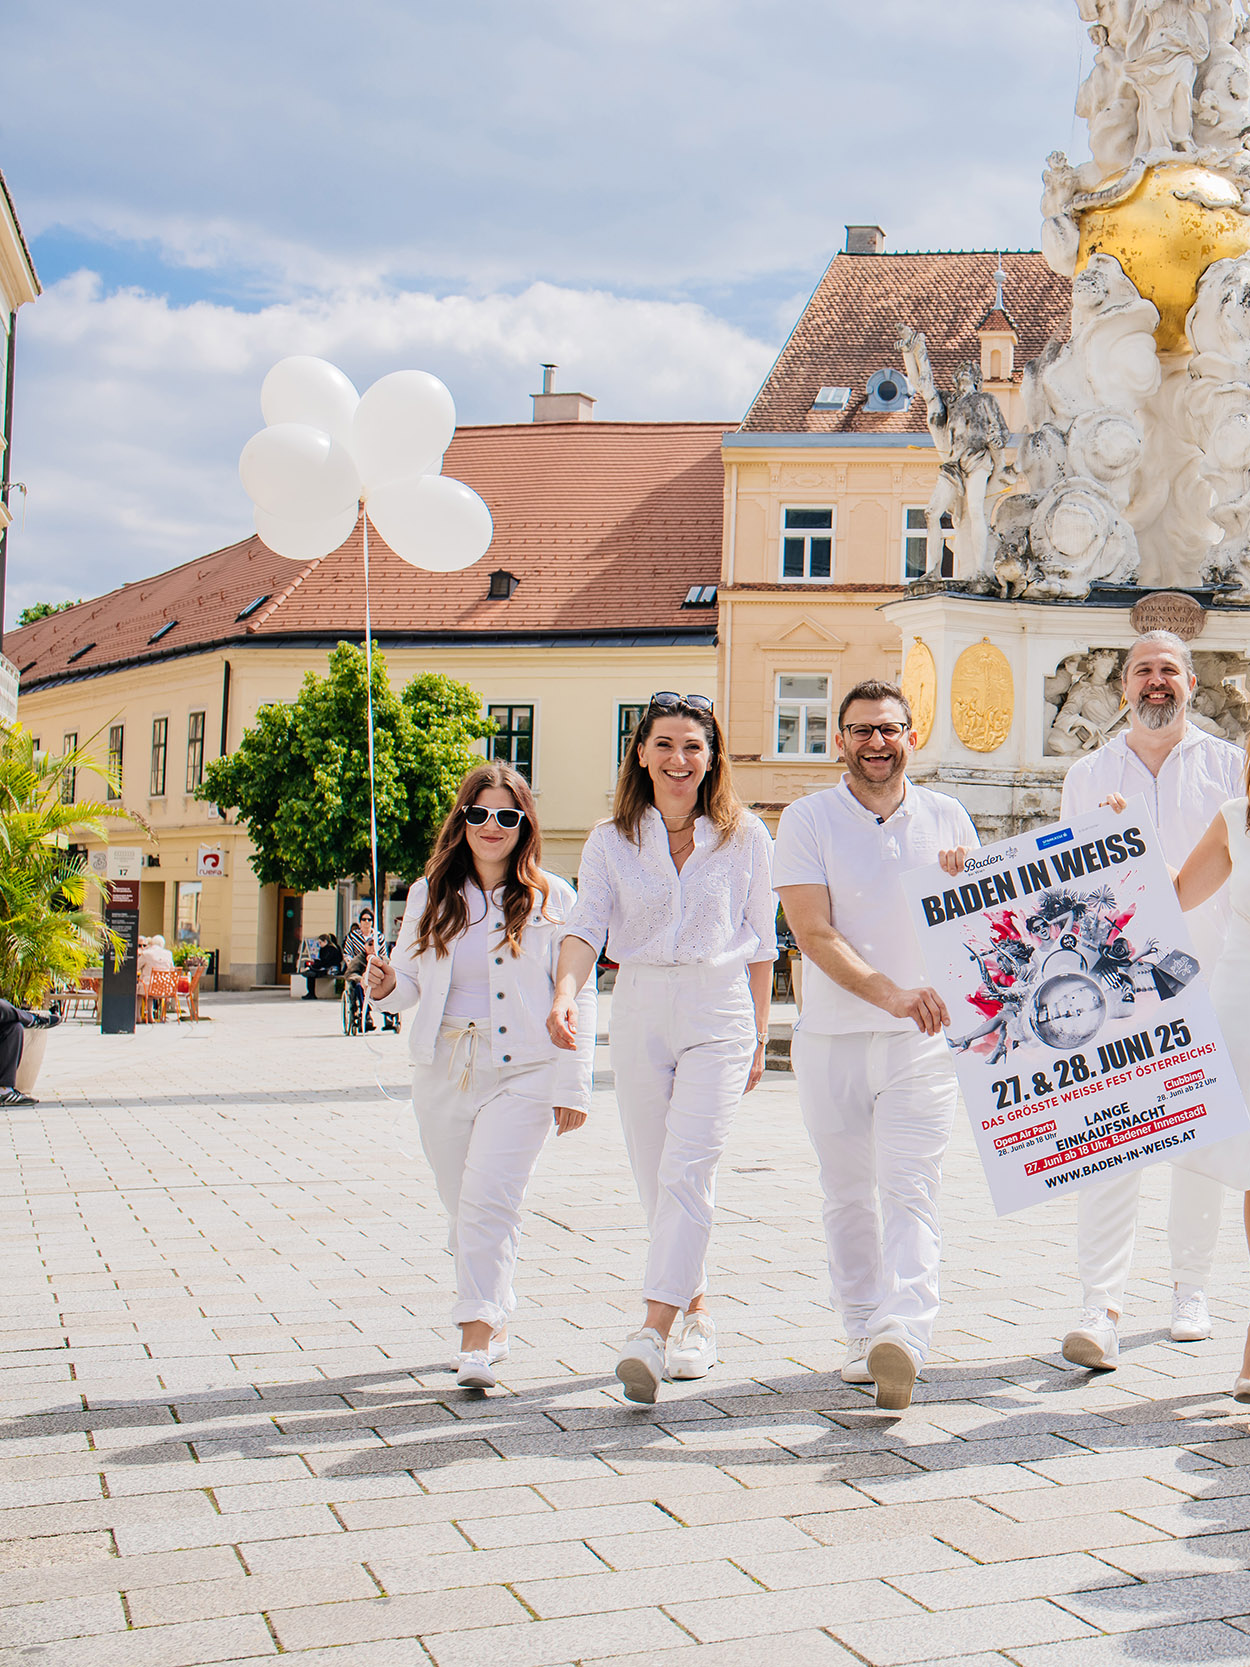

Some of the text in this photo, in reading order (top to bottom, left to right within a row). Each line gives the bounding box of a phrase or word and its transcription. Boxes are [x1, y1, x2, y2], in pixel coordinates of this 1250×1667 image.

[119, 868, 128, 876] 17
[199, 868, 222, 876] ruefa
[921, 827, 1147, 927] BADEN IN WEISS
[964, 854, 1005, 873] Baden
[991, 1018, 1193, 1110] 27. & 28. JUNI 25
[981, 1042, 1217, 1131] DAS GRÖSSTE WEISSE FEST ÖSTERREICHS!
[1156, 1076, 1218, 1102] 28. Juni ab 22 Uhr
[1166, 1071, 1204, 1090] Clubbing
[1056, 1104, 1166, 1151] EINKAUFSNACHT
[1084, 1101, 1131, 1127] LANGE
[995, 1122, 1056, 1150] Open Air Party
[998, 1131, 1057, 1157] 28. Juni ab 18 Uhr
[1026, 1106, 1206, 1175] 27. Juni ab 18 Uhr, Badener Innenstadt
[1045, 1129, 1197, 1189] WWW.BADEN-IN-WEISS.AT
